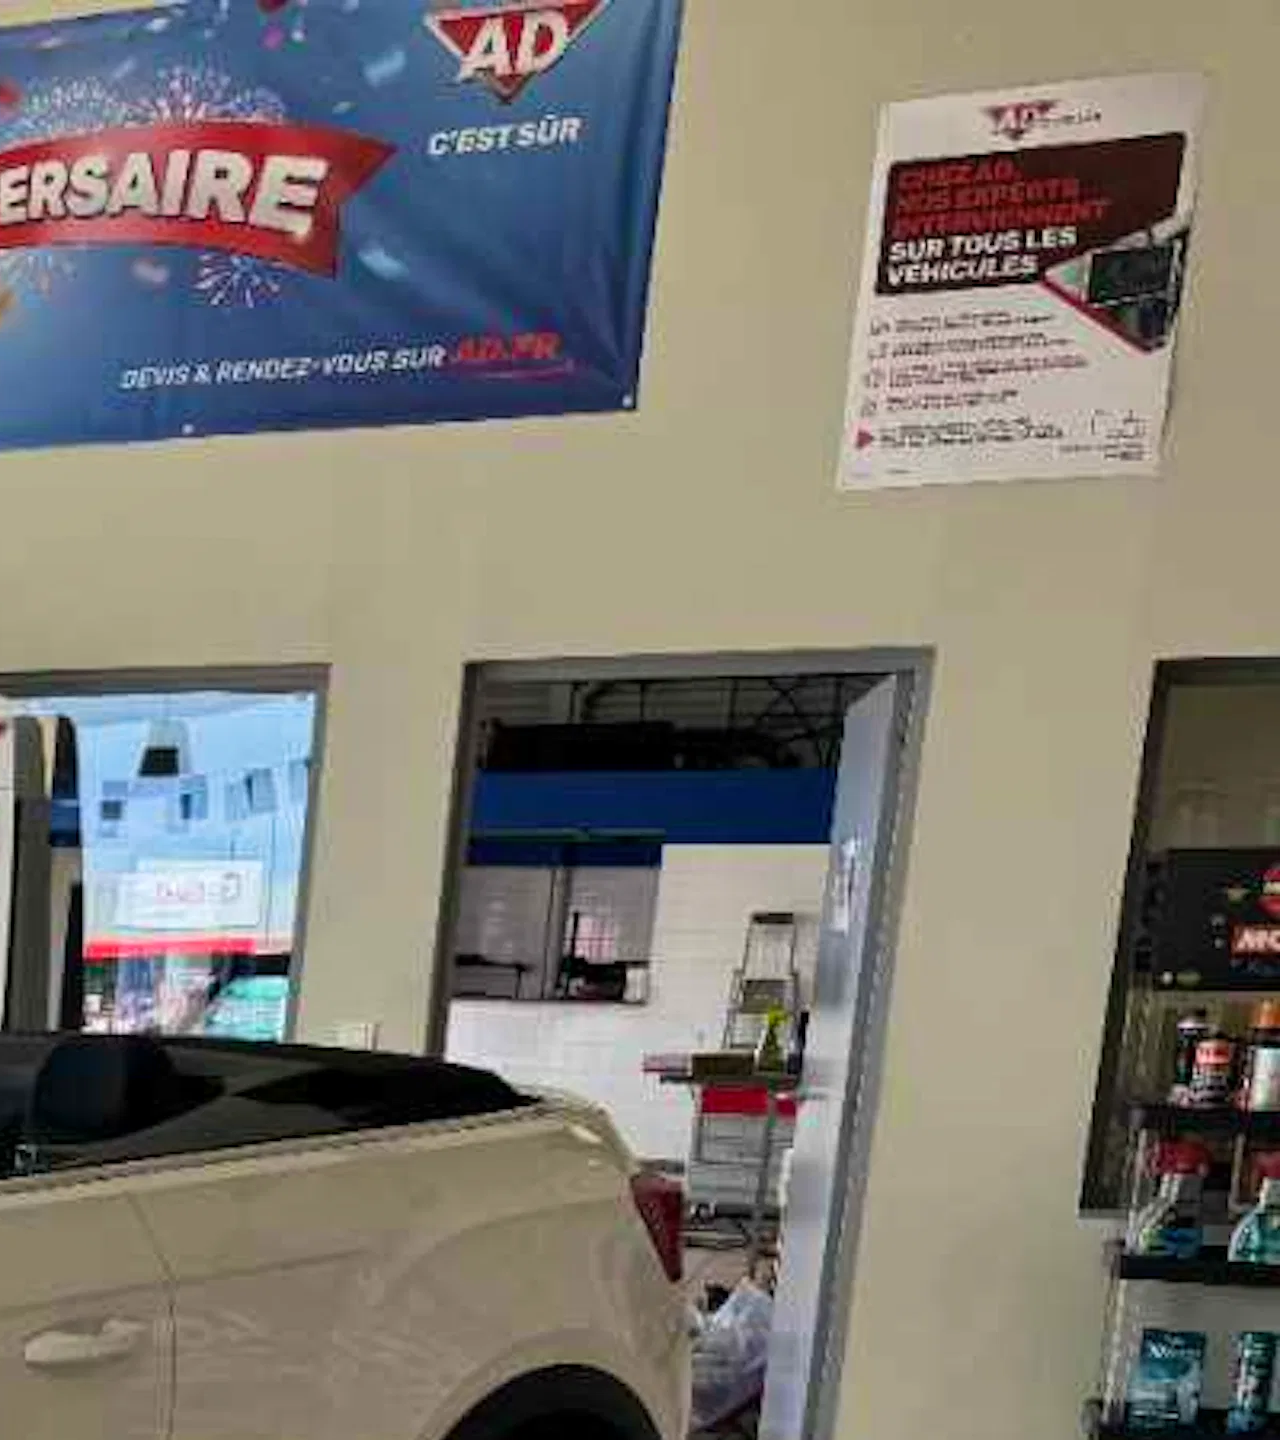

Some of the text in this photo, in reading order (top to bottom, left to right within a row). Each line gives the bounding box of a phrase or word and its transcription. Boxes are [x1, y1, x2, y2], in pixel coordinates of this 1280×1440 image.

[454, 9, 570, 82] AD
[427, 124, 513, 156] C'EST
[889, 225, 1078, 262] SUR TOUS LES
[118, 362, 188, 390] DEVIS
[194, 361, 212, 385] &
[216, 349, 389, 384] RENDEZ-VOUS
[391, 344, 448, 373] SUR
